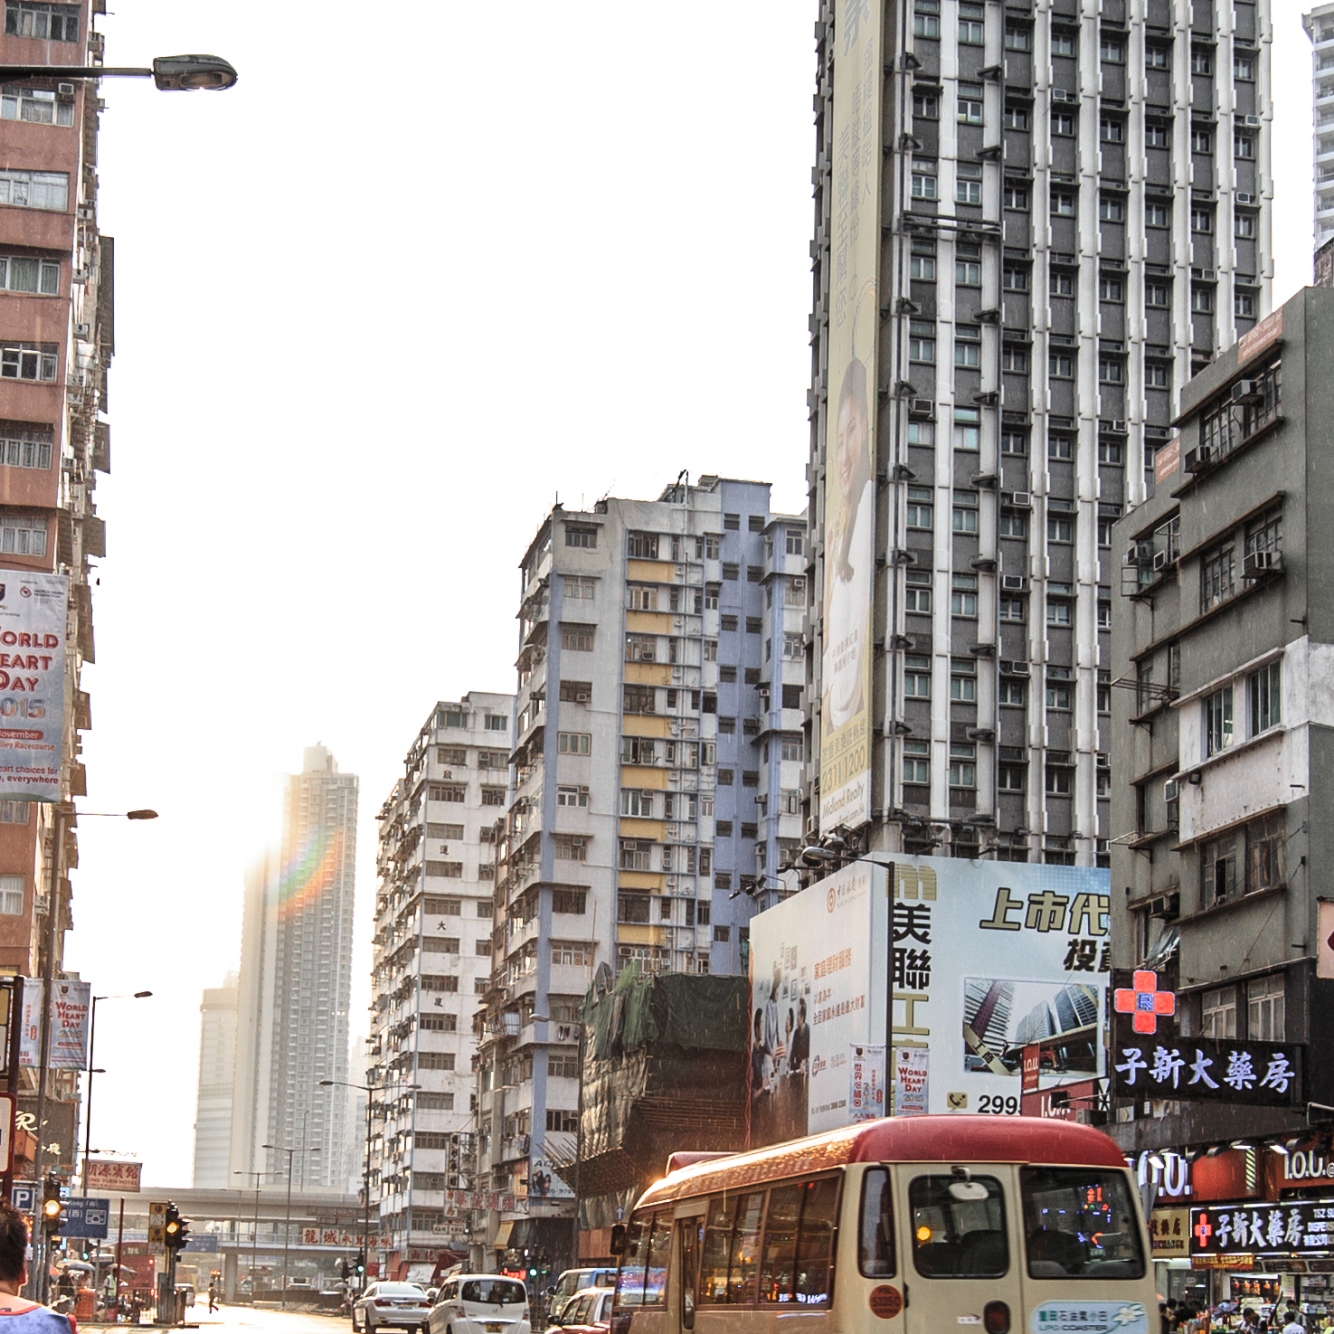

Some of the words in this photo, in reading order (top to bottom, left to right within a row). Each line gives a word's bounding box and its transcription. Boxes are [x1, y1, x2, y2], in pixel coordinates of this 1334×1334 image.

[15, 740, 55, 751] Racecourse
[0, 763, 17, 774] heart
[18, 764, 46, 775] choices
[47, 766, 58, 775] for
[7, 774, 59, 785] everywhere
[55, 1002, 87, 1012] WORLD
[58, 1010, 85, 1021] HEART
[62, 1020, 79, 1029] DAY
[898, 1067, 927, 1077] WORLD
[1115, 1046, 1295, 1093] 子新大藥房
[900, 1075, 925, 1084] HEART
[905, 1083, 922, 1092] DAY
[977, 1094, 1021, 1114] 299
[1215, 1209, 1305, 1248] 子新大藥房
[1061, 1323, 1108, 1331] COASTER
